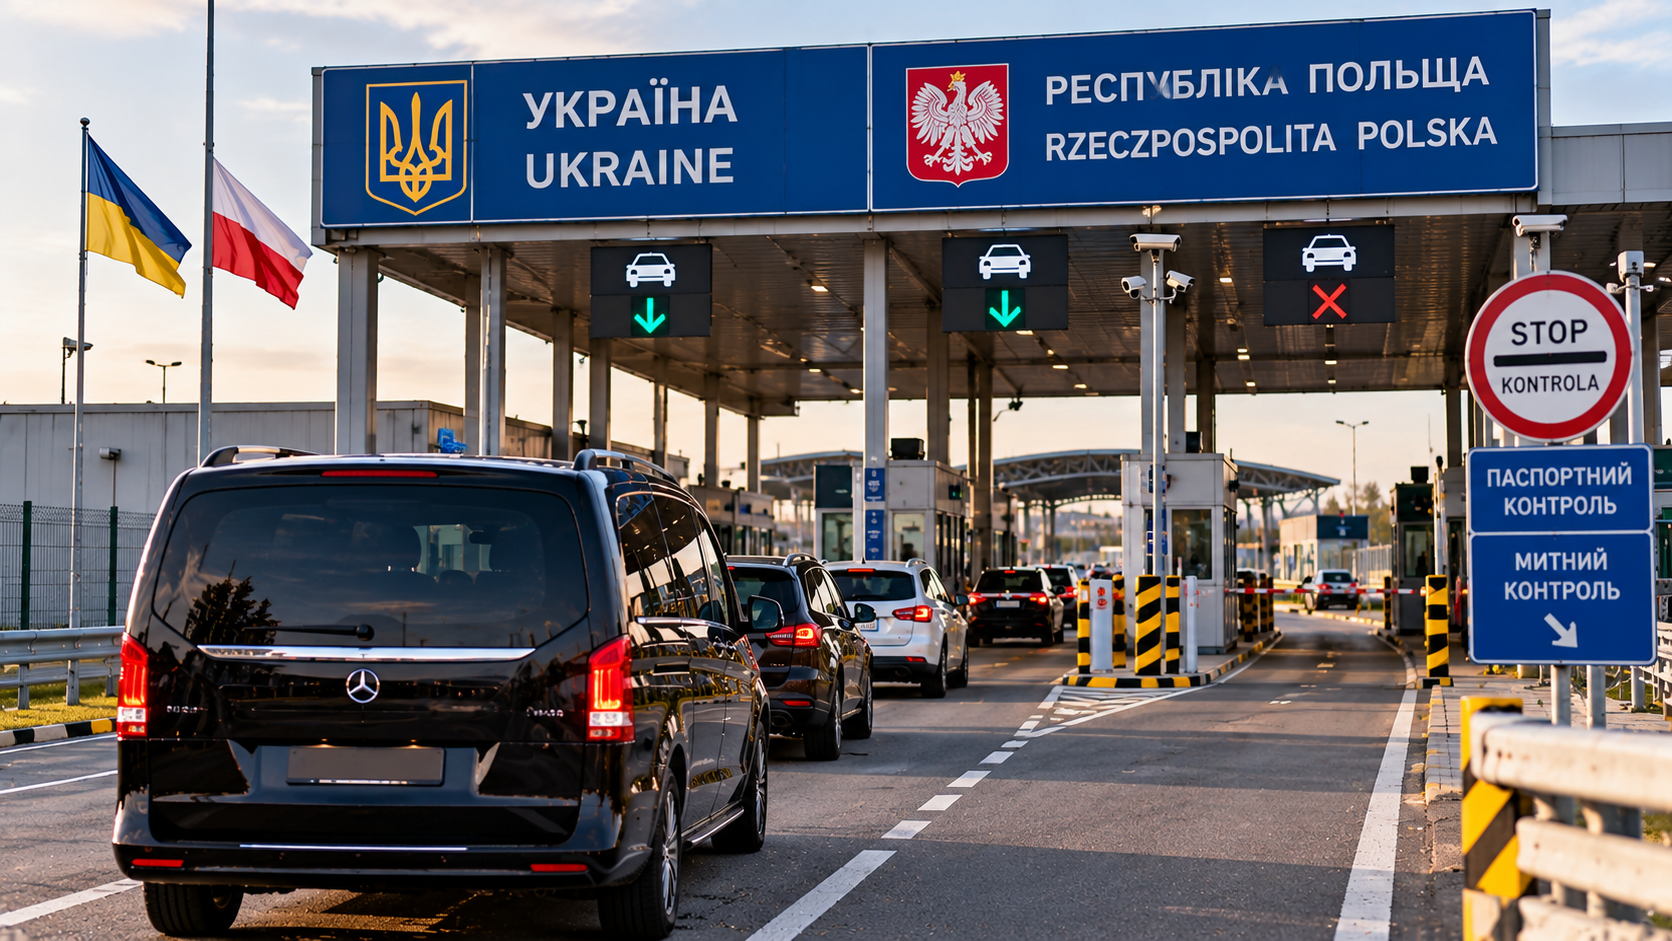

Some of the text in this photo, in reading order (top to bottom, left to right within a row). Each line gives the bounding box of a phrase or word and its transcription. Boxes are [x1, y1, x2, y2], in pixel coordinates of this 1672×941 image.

[1309, 55, 1490, 94] ПОЛЬЩА
[522, 77, 738, 130] УКРАЇНА
[1046, 116, 1498, 162] RZECZPOSPOLITA POLSKA
[526, 147, 734, 189] UKRAINE
[1511, 319, 1588, 346] STOP
[1501, 374, 1600, 394] KONTROLA
[1487, 461, 1632, 487] ПАСПОРТНИЙ
[1504, 495, 1617, 516] КОНТРОЛЬ
[1515, 547, 1608, 571] МИТНИЙ
[1504, 580, 1621, 600] КОНТРОЛЬ
